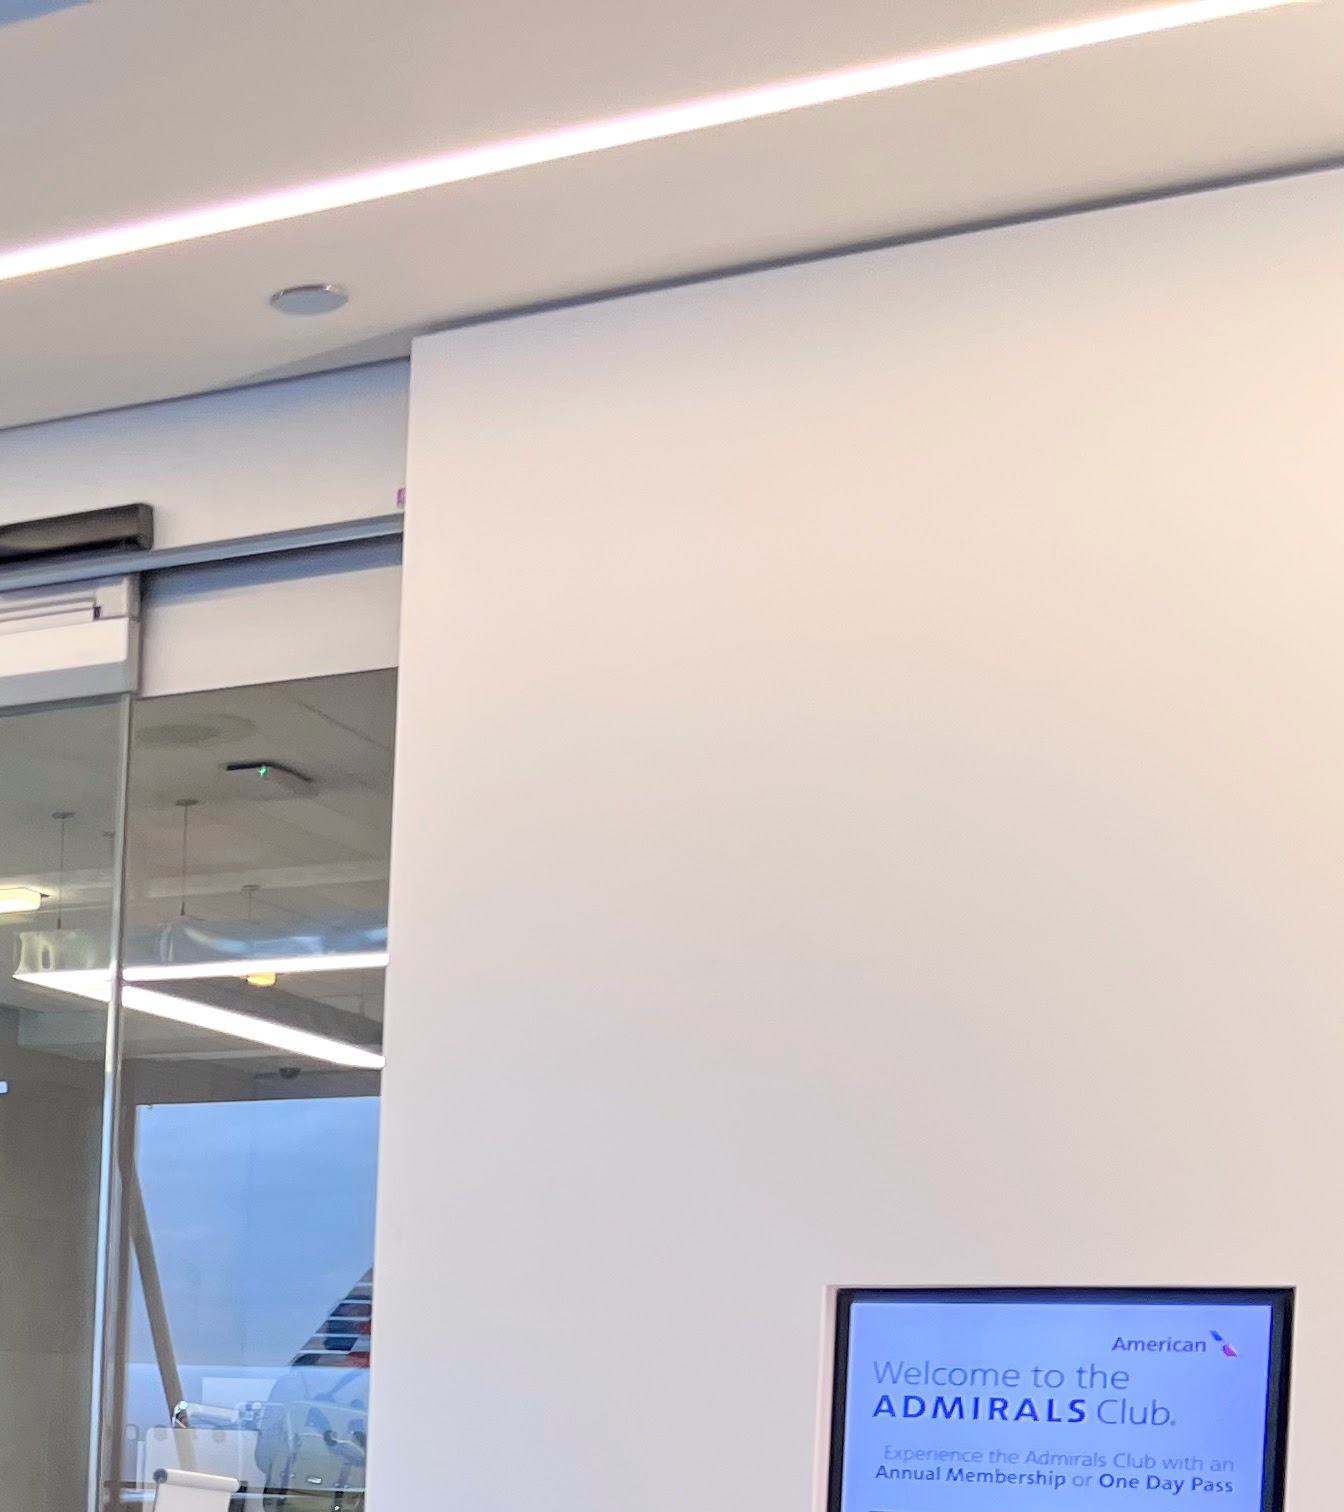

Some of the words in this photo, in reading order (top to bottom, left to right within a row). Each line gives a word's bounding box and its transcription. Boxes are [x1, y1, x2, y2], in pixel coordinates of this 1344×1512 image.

[1112, 1337, 1207, 1353] American
[873, 1360, 1021, 1388] Welcome
[1032, 1366, 1065, 1389] to
[1077, 1364, 1131, 1390] the
[872, 1394, 1087, 1424] ADMIRALS
[884, 1445, 983, 1466] Experience
[989, 1449, 1020, 1465] the
[1024, 1450, 1108, 1469] Admirals
[1113, 1453, 1157, 1470] Club
[1162, 1456, 1204, 1472] with
[1210, 1460, 1235, 1473] an
[875, 1465, 942, 1482] Annual
[945, 1467, 1067, 1488] Membership
[1072, 1475, 1093, 1488] or
[1099, 1473, 1141, 1490] One
[1146, 1474, 1185, 1497] Day
[1192, 1477, 1235, 1494] Pass
